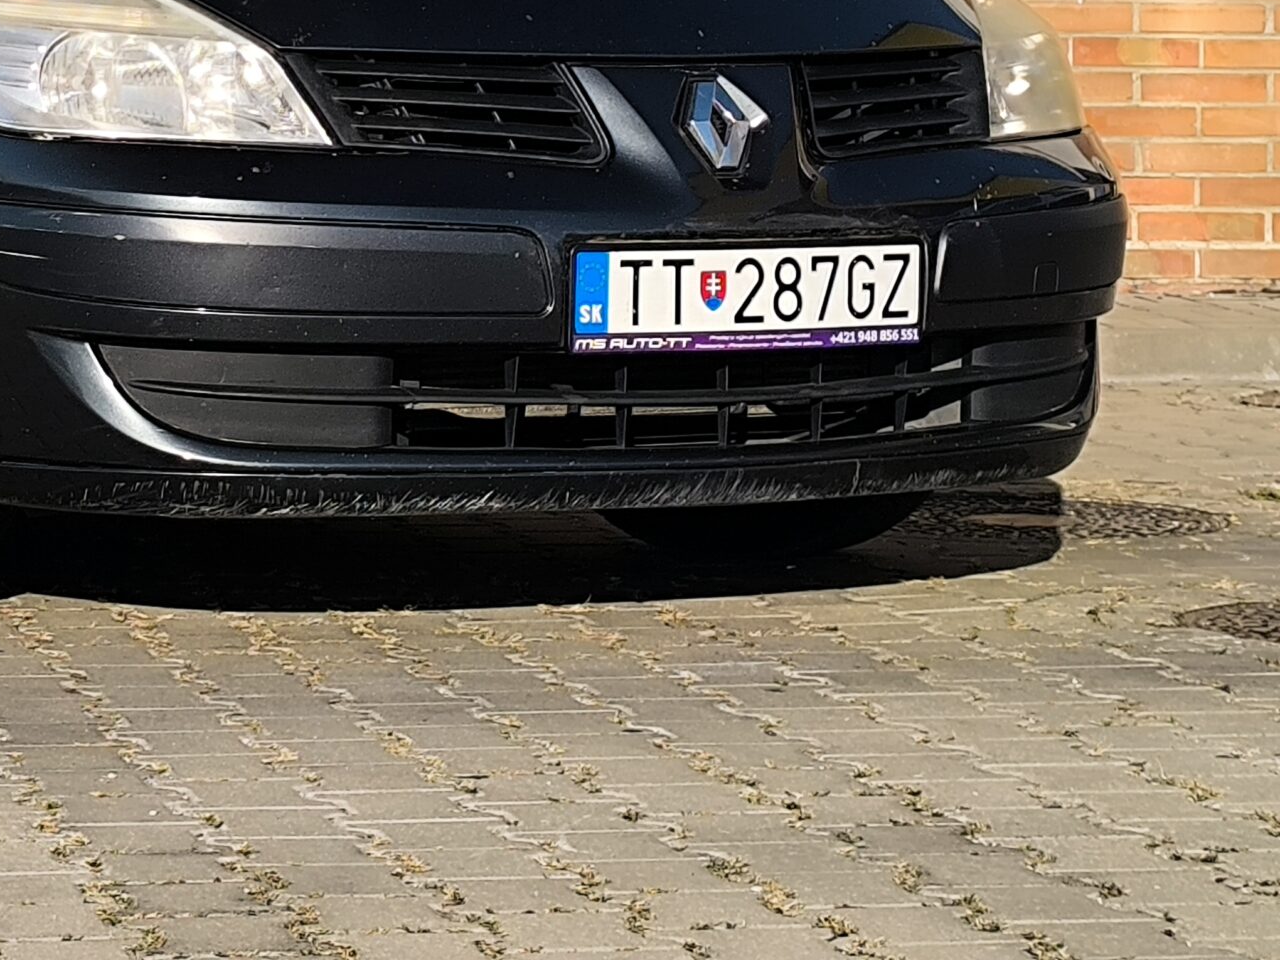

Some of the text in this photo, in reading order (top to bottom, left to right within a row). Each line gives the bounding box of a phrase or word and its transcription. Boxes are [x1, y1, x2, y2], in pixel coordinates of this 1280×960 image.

[620, 254, 911, 326] TT 287GZ
[579, 304, 603, 324] SK
[575, 338, 606, 351] MS
[830, 328, 919, 344] +421 948 856 551
